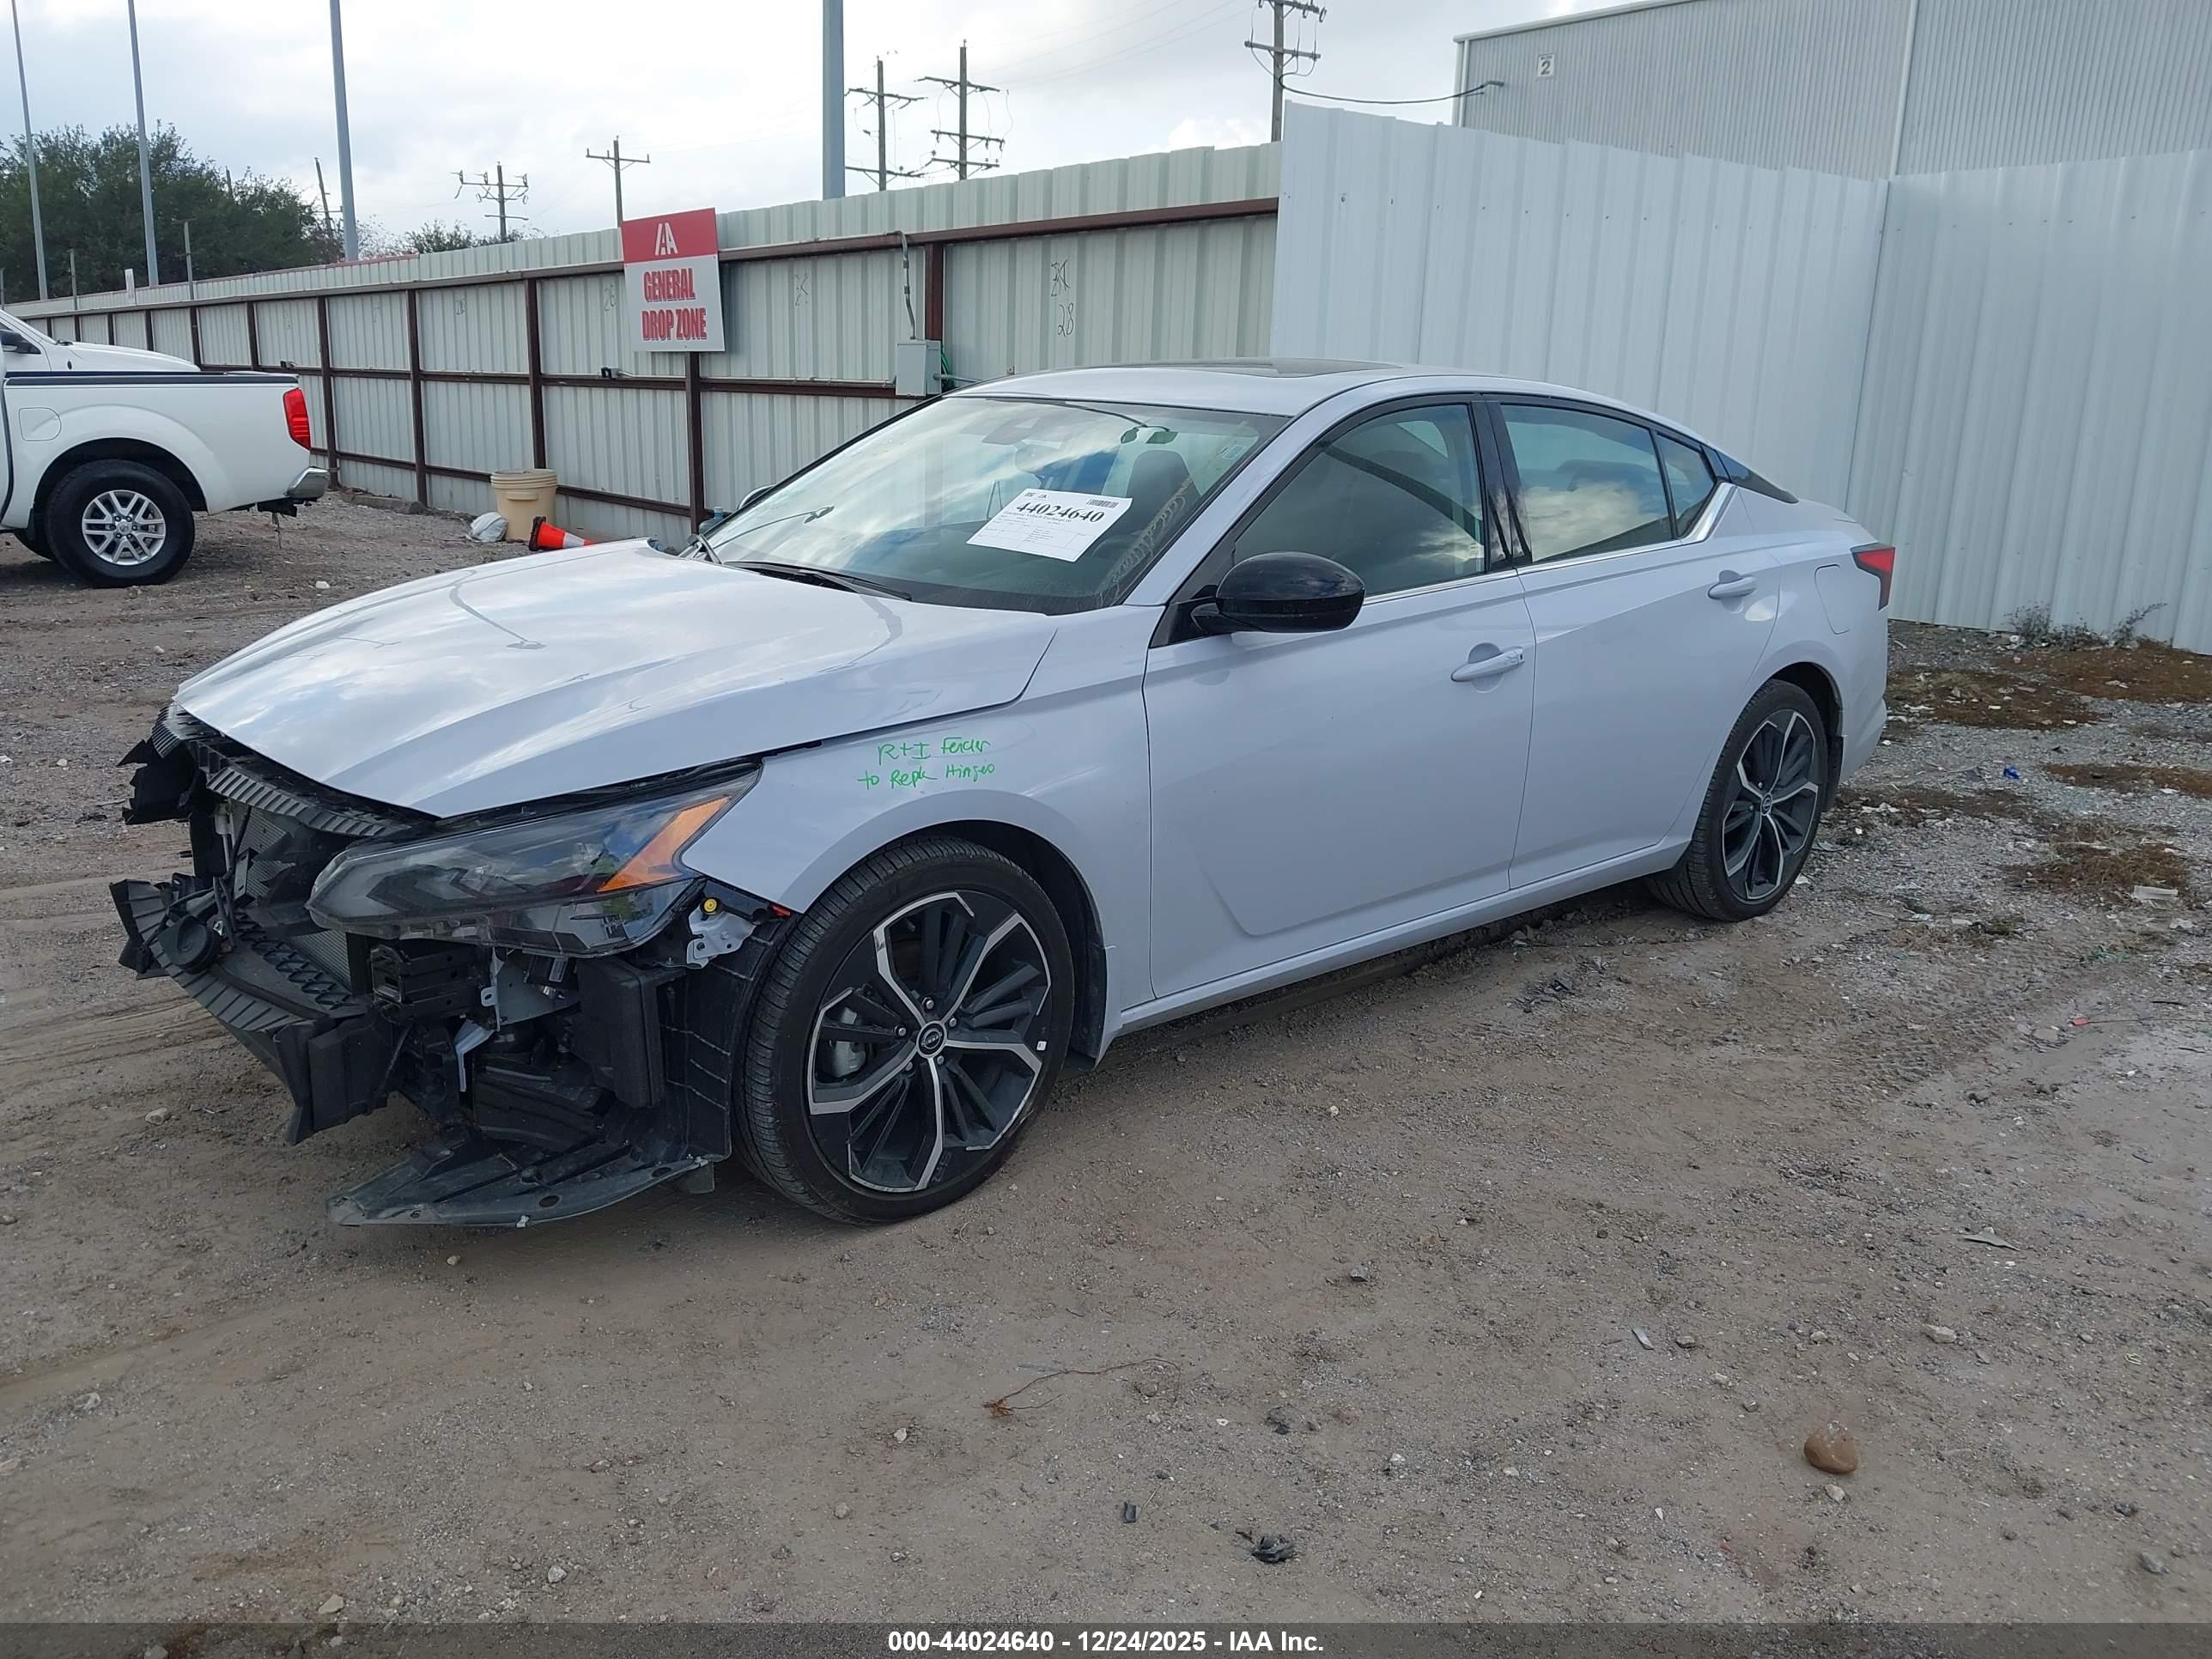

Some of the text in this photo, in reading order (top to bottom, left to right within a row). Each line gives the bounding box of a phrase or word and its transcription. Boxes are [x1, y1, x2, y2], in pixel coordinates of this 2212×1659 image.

[1540, 60, 1551, 76] 2
[643, 268, 696, 302] GENERAL
[642, 307, 708, 341] DROP ZONE
[1057, 302, 1074, 337] 28
[1016, 501, 1105, 523] 44024640
[857, 770, 880, 790] to
